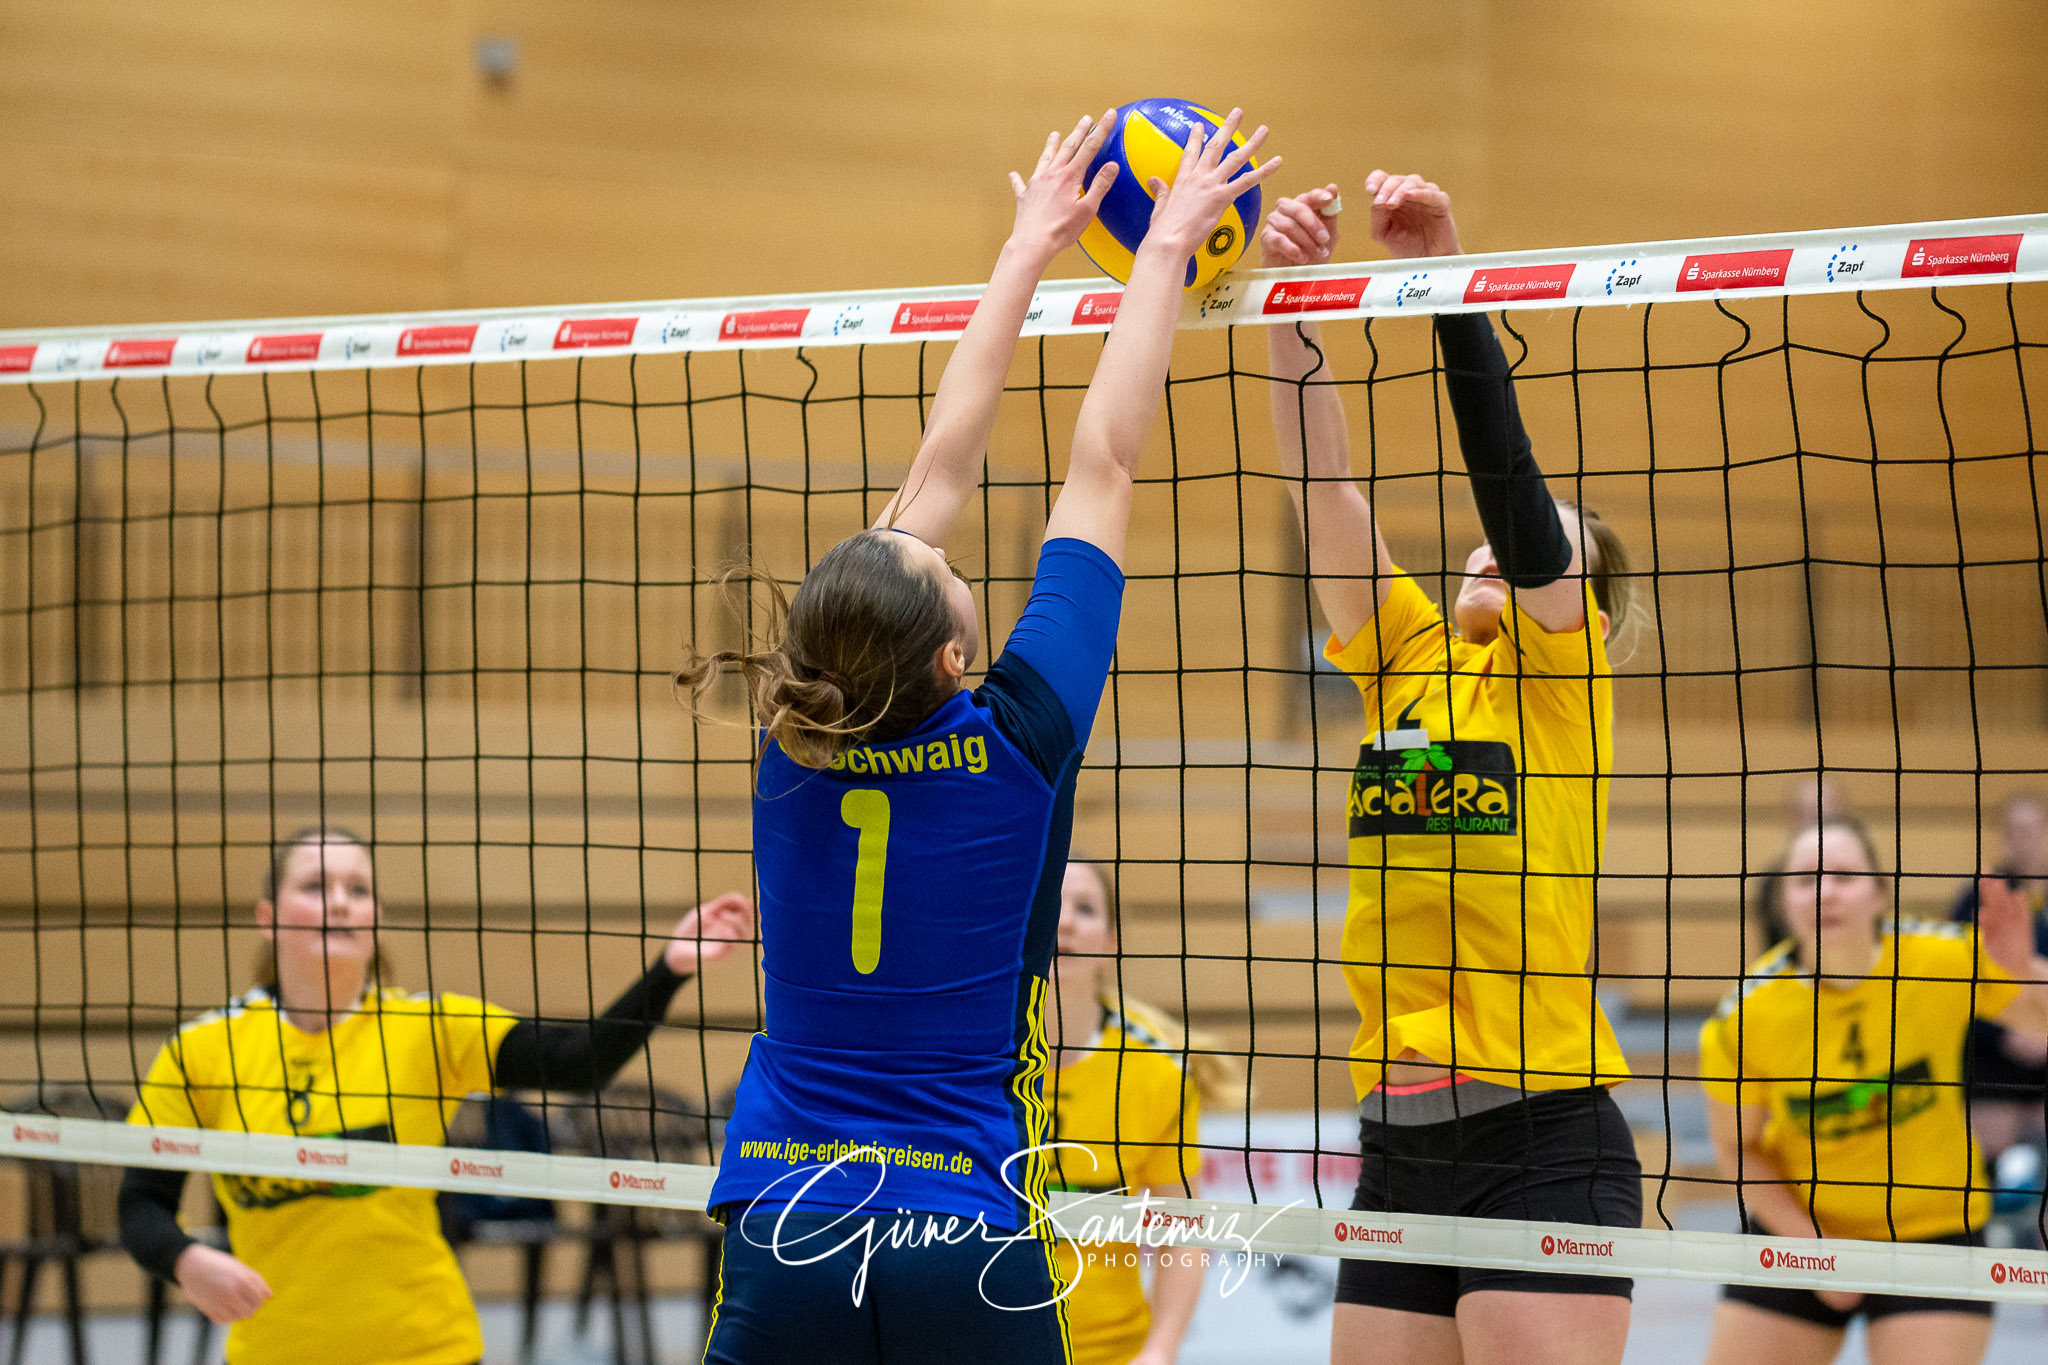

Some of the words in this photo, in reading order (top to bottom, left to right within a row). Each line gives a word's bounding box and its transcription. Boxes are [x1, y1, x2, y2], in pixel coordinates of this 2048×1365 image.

[1837, 260, 1865, 274] Zapf
[1926, 254, 1969, 267] Sparkasse
[1969, 252, 2010, 265] Nürnberg
[1616, 274, 1643, 288] Zapf
[1700, 269, 1741, 281] Sparkasse
[1741, 266, 1780, 278] Nürnberg
[1406, 286, 1431, 300] Zapf
[1486, 281, 1526, 294] Sparkasse
[1526, 279, 1562, 291] Nürnberg
[1209, 298, 1234, 311] Zapf
[1284, 294, 1321, 306] Sparkasse
[1321, 291, 1356, 303] Nürnberg
[910, 314, 944, 326] Sparkasse
[1025, 308, 1044, 322] apf
[842, 318, 864, 330] Zapf
[670, 326, 691, 338] Zapf
[1425, 817, 1511, 832] RESAURANT
[841, 788, 891, 975] 1
[740, 1138, 973, 1175] www.ige-erlebnisreisen.de
[461, 1160, 504, 1179] Marmot
[622, 1173, 666, 1191] Marmot
[1349, 1224, 1403, 1244] Marmot
[1556, 1238, 1613, 1257] Marmot
[1776, 1250, 1836, 1272] Marmot
